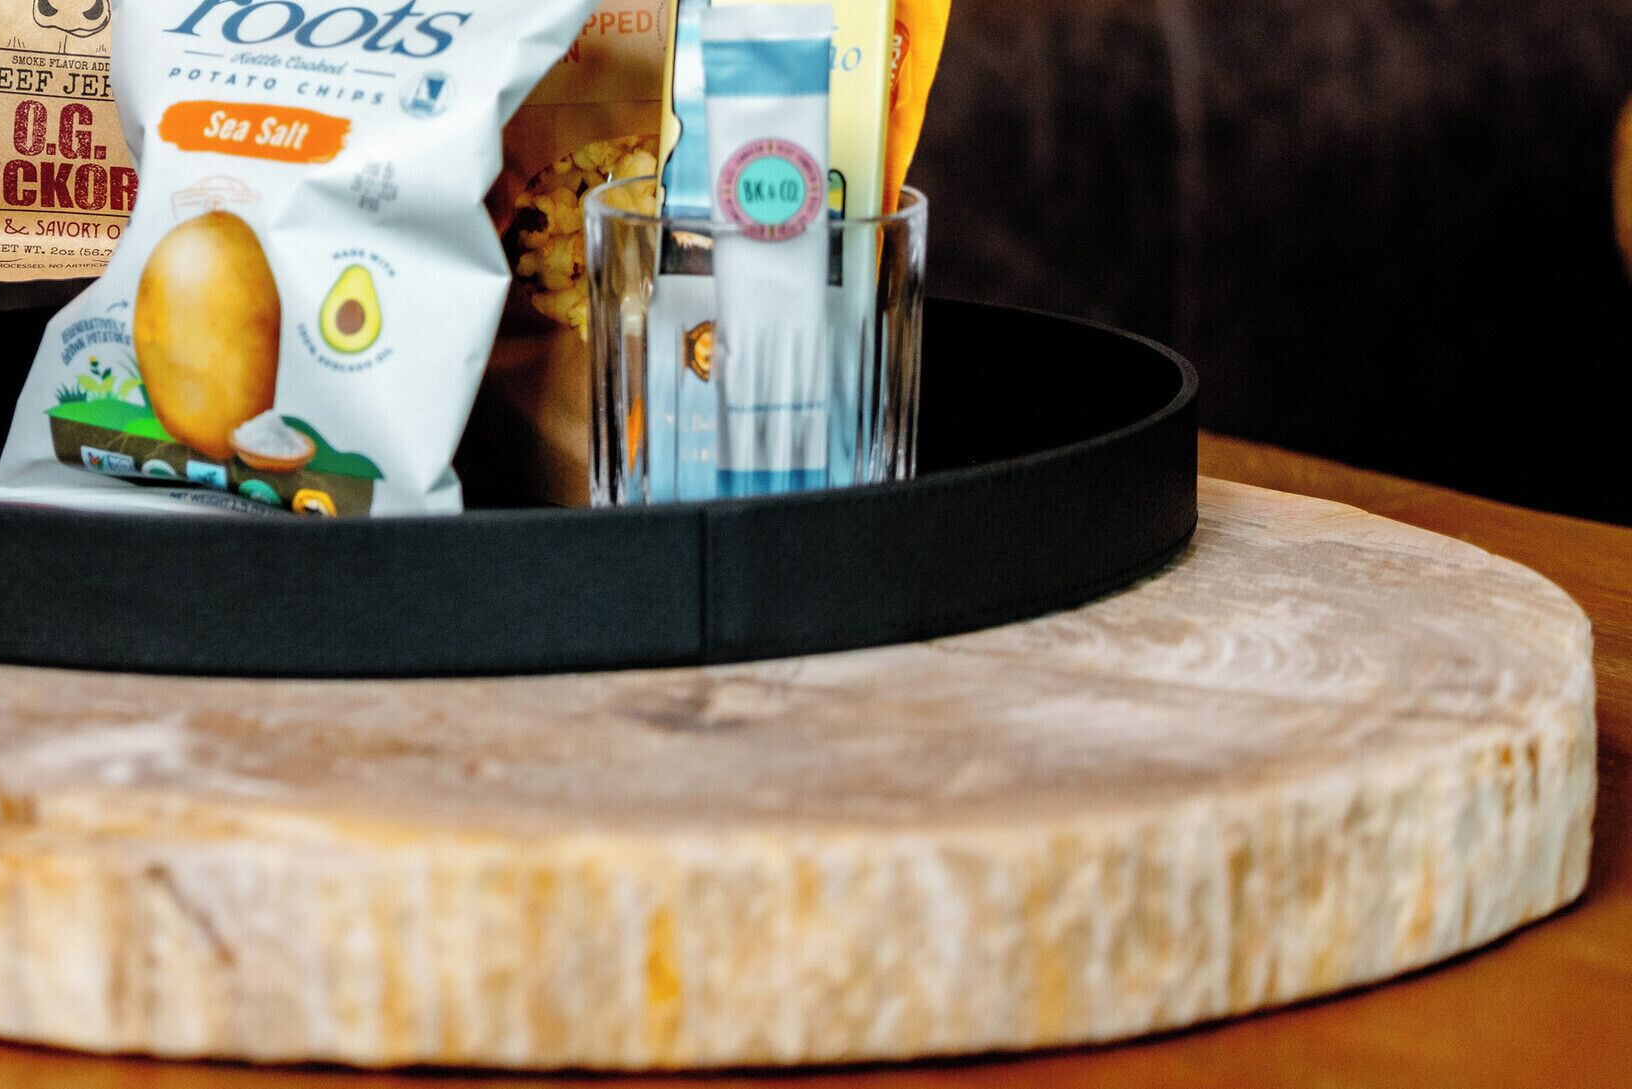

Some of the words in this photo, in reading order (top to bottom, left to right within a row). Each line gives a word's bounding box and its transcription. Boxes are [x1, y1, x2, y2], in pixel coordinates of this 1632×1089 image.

[12, 55, 47, 67] SMOKE
[49, 58, 89, 71] FLAVOR
[168, 67, 278, 90] POTATO
[296, 82, 385, 105] CHIPS
[13, 99, 107, 160] O.G.
[204, 110, 251, 143] Sea
[255, 116, 310, 151] Salt
[4, 219, 29, 236] &
[35, 220, 101, 239] SAVORY
[23, 245, 46, 255] WT.
[50, 246, 75, 257] 2oz
[332, 248, 365, 261] MADE
[370, 253, 396, 278] WITH
